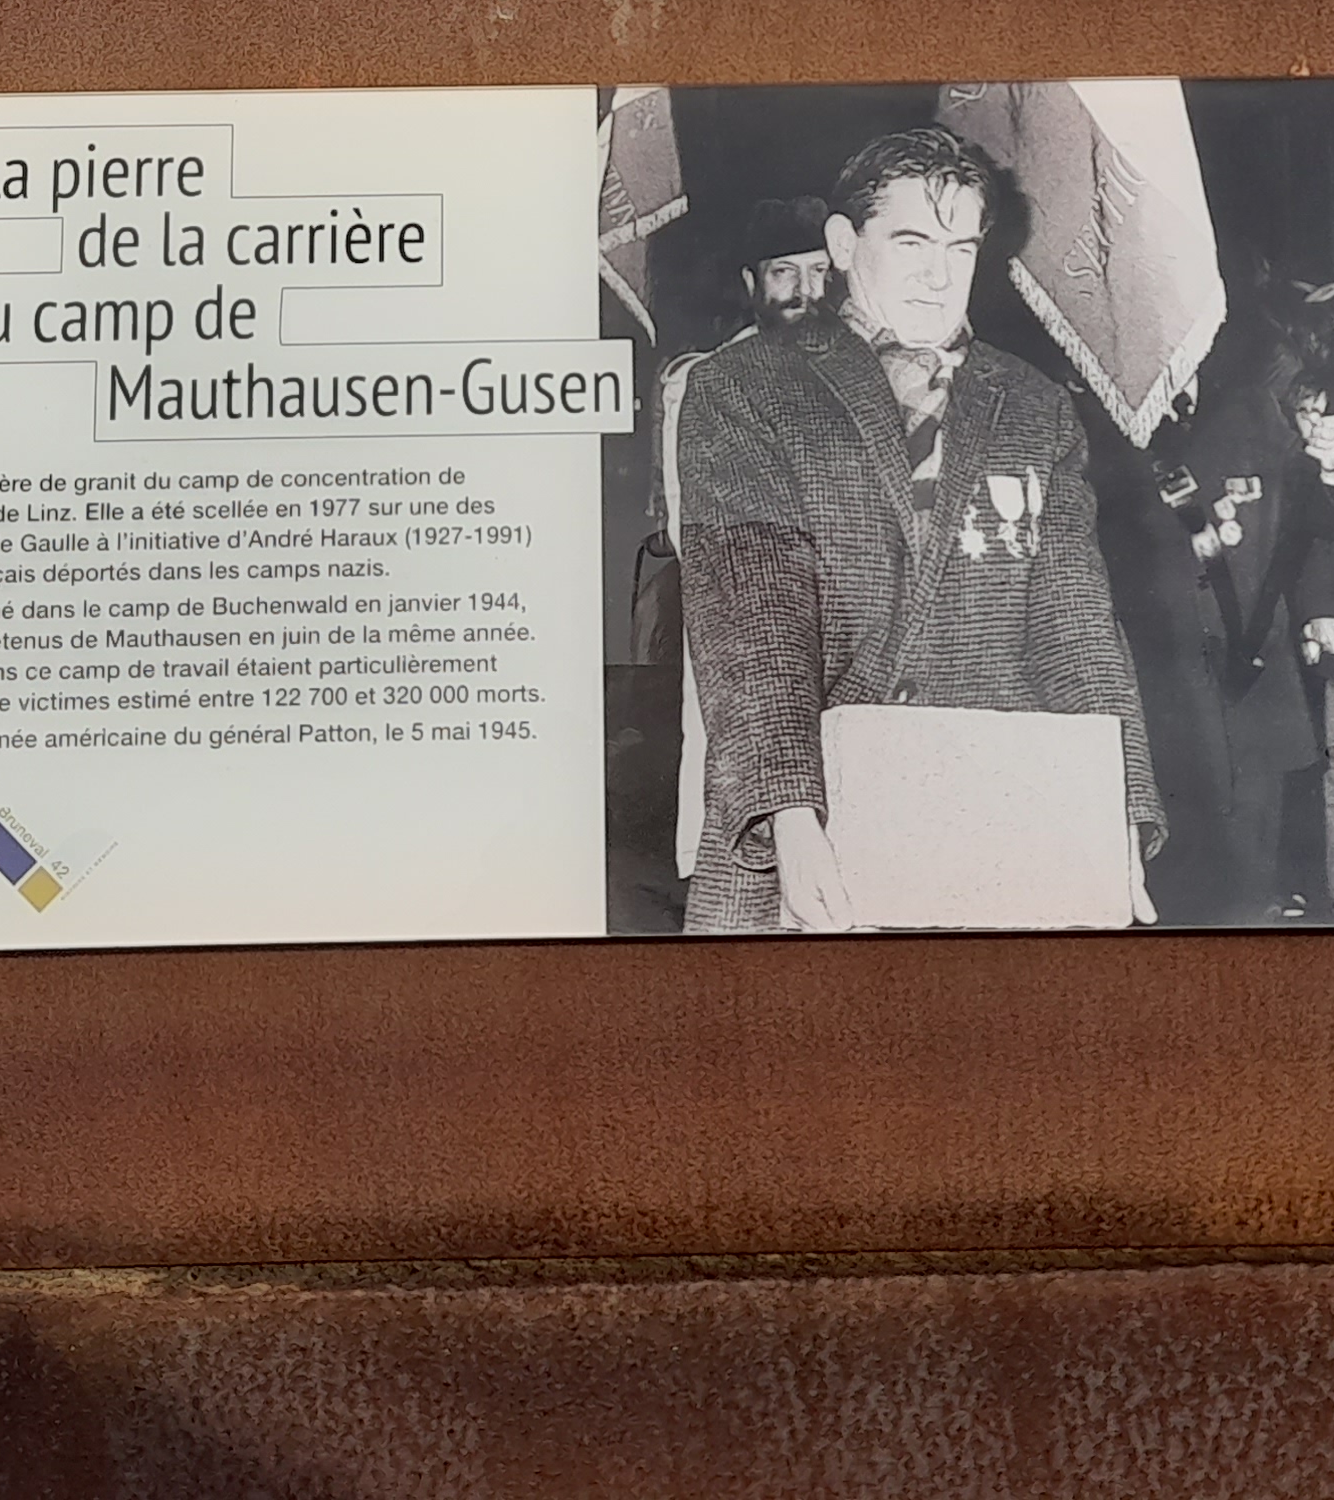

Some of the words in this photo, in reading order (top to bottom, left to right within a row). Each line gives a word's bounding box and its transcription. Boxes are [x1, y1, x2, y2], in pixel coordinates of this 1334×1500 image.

[52, 143, 204, 214] pierre
[78, 212, 139, 268] de
[163, 211, 204, 267] la
[227, 207, 425, 266] carrière
[34, 300, 173, 356] camp
[195, 284, 256, 340] de
[109, 358, 620, 421] Mauthausen-Gusen
[38, 473, 67, 493] de
[73, 471, 137, 497] granit
[143, 471, 172, 491] du
[177, 474, 240, 494] camp
[246, 469, 274, 489] de
[280, 466, 431, 488] concentration
[438, 466, 466, 486] de
[27, 503, 77, 523] Linz.
[85, 501, 125, 522] Elle
[130, 505, 145, 521] a
[151, 500, 186, 521] été
[192, 498, 269, 520] scellée
[275, 502, 302, 519] en
[309, 497, 361, 518] 1977
[368, 501, 404, 517] sur
[409, 500, 449, 516] une
[455, 495, 496, 516] des
[20, 532, 90, 553] Gaulle
[96, 531, 110, 552] à
[320, 528, 398, 548] Haraux
[405, 524, 532, 551] (1927-1991)
[42, 561, 142, 587] déportés
[148, 561, 203, 581] dans
[209, 560, 240, 580] les
[246, 563, 321, 583] camps
[327, 557, 390, 578] nazis.
[21, 600, 76, 620] dans
[82, 599, 102, 619] le
[108, 602, 171, 622] camp
[176, 597, 205, 617] de
[212, 594, 348, 616] Buchenwald
[354, 598, 382, 614] en
[387, 593, 462, 618] janvier
[468, 592, 526, 614] 1944,
[69, 629, 99, 650] de
[105, 628, 241, 649] Mauthausen
[248, 630, 275, 646] en
[281, 625, 321, 651] juin
[327, 625, 356, 645] de
[362, 624, 382, 644] la
[388, 623, 456, 644] même
[462, 621, 536, 643] année.
[25, 665, 52, 681] ce
[58, 664, 121, 684] camp
[127, 659, 156, 679] de
[162, 657, 230, 678] travail
[236, 656, 312, 677] étaient
[318, 653, 498, 680] particulièrement
[18, 691, 111, 712] victimes
[117, 688, 192, 710] estimé
[198, 689, 255, 709] entre
[261, 687, 302, 707] 122
[308, 686, 348, 707] 700
[354, 687, 377, 706] et
[382, 685, 423, 706] 320
[429, 684, 470, 705] 000
[476, 684, 546, 704] morts.
[44, 726, 167, 749] américaine
[173, 725, 202, 746] du
[208, 723, 291, 750] général
[298, 723, 378, 745] Patton,
[385, 722, 405, 742] le
[410, 721, 424, 742] 5
[431, 720, 471, 741] mai
[478, 720, 537, 741] 1945.
[51, 860, 70, 880] 42
